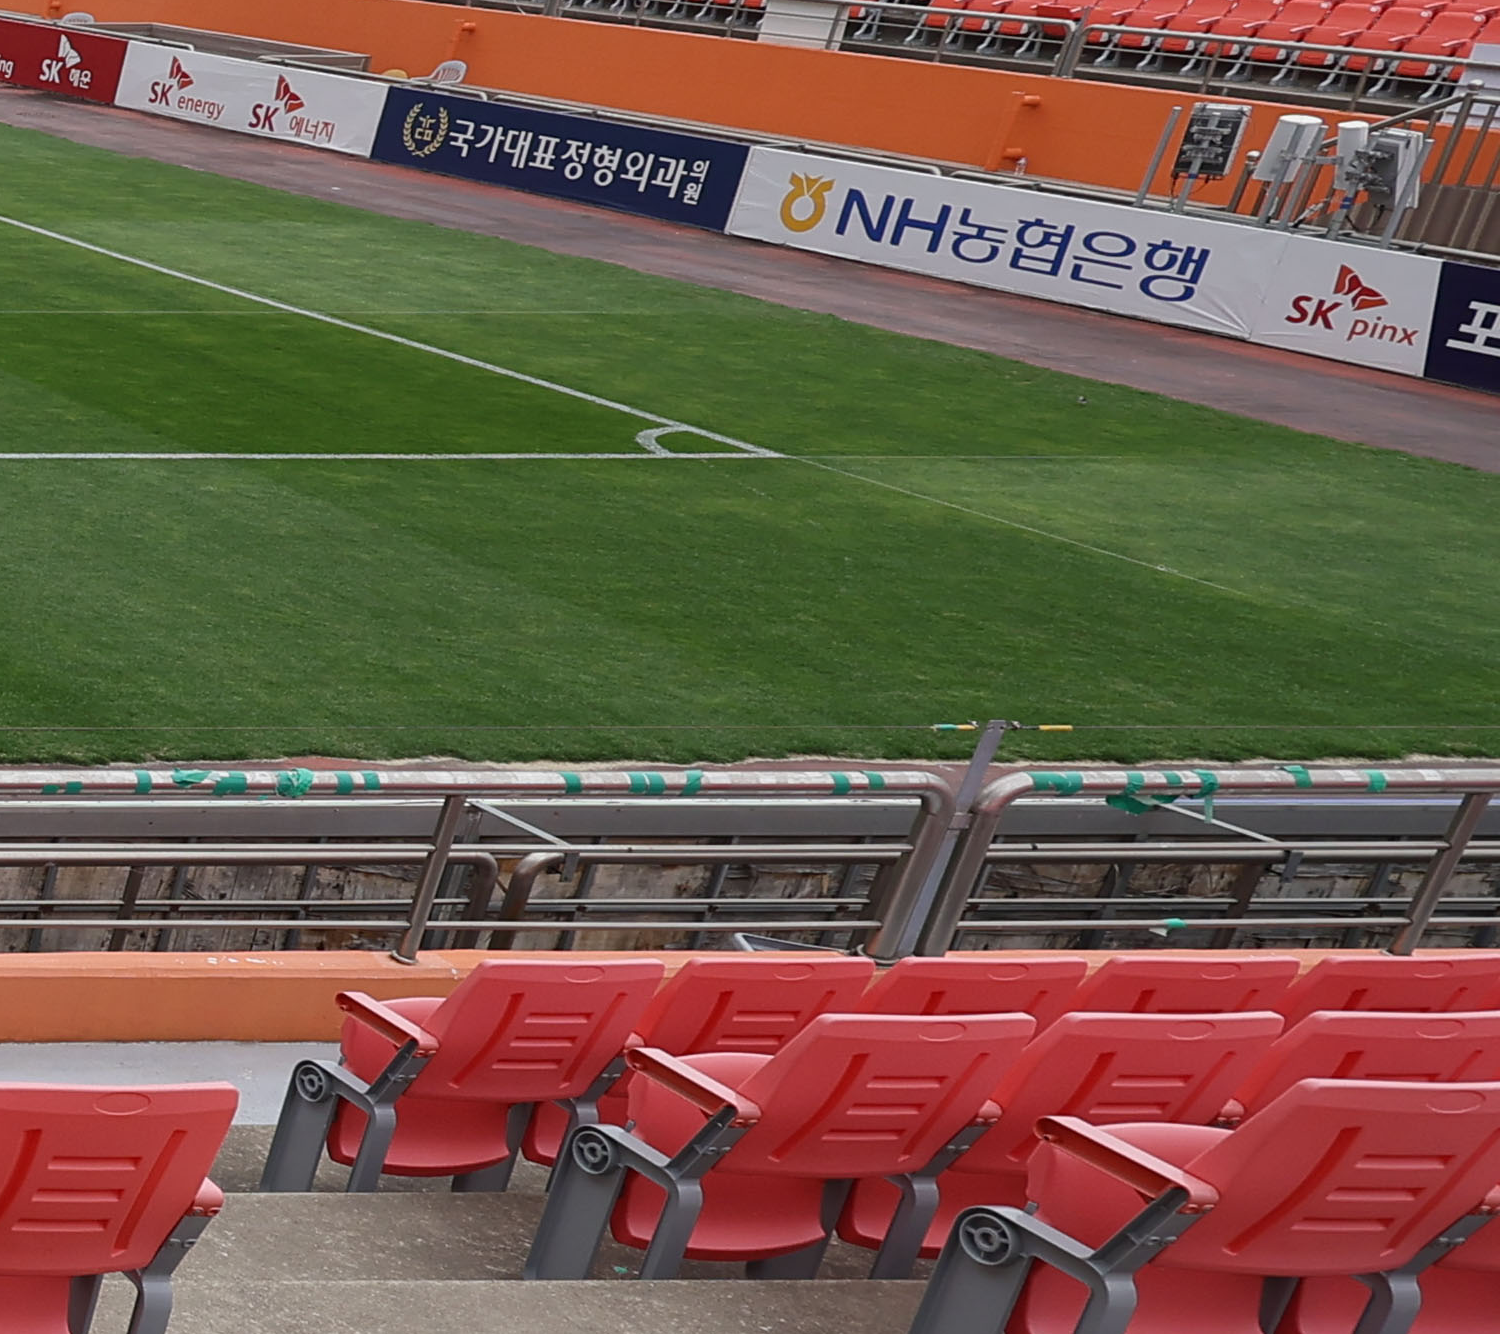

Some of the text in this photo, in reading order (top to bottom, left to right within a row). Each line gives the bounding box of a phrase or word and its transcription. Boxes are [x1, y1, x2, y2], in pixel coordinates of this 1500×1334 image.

[39, 58, 92, 90] SK 해운
[148, 80, 224, 120] SK energy
[248, 103, 335, 142] SK 에너지
[448, 119, 688, 199] 국가대표정형외과
[835, 189, 1211, 304] NH농협은행
[1285, 295, 1419, 347] SK pinx
